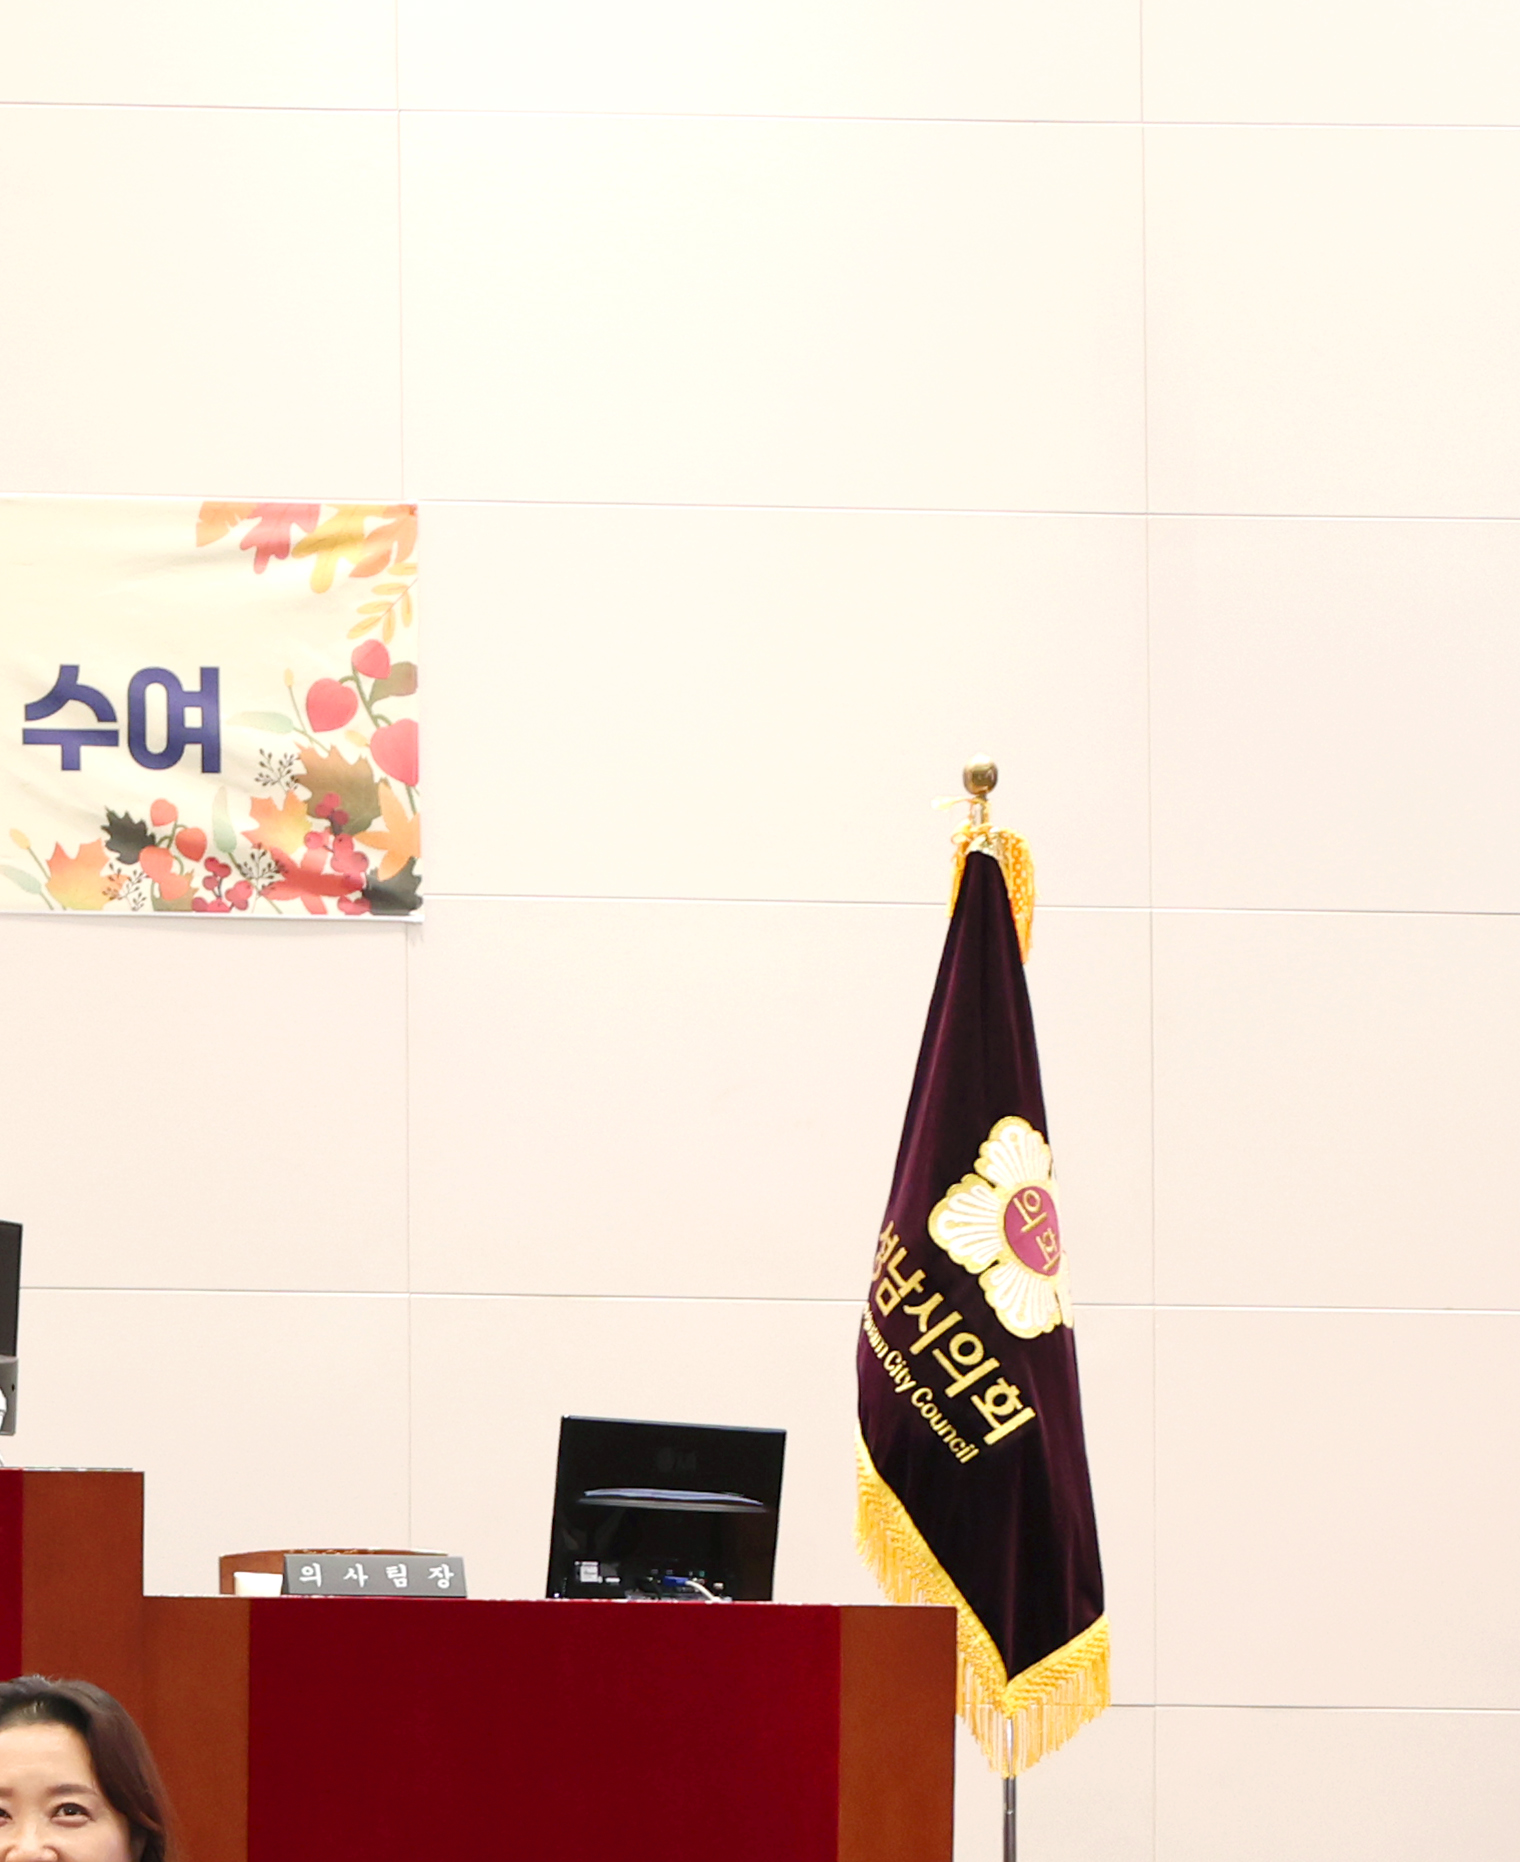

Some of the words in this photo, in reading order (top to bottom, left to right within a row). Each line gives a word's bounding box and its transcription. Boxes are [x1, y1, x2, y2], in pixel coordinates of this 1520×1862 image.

[22, 664, 222, 775] 수여
[883, 1349, 917, 1393] City
[911, 1387, 979, 1463] Council
